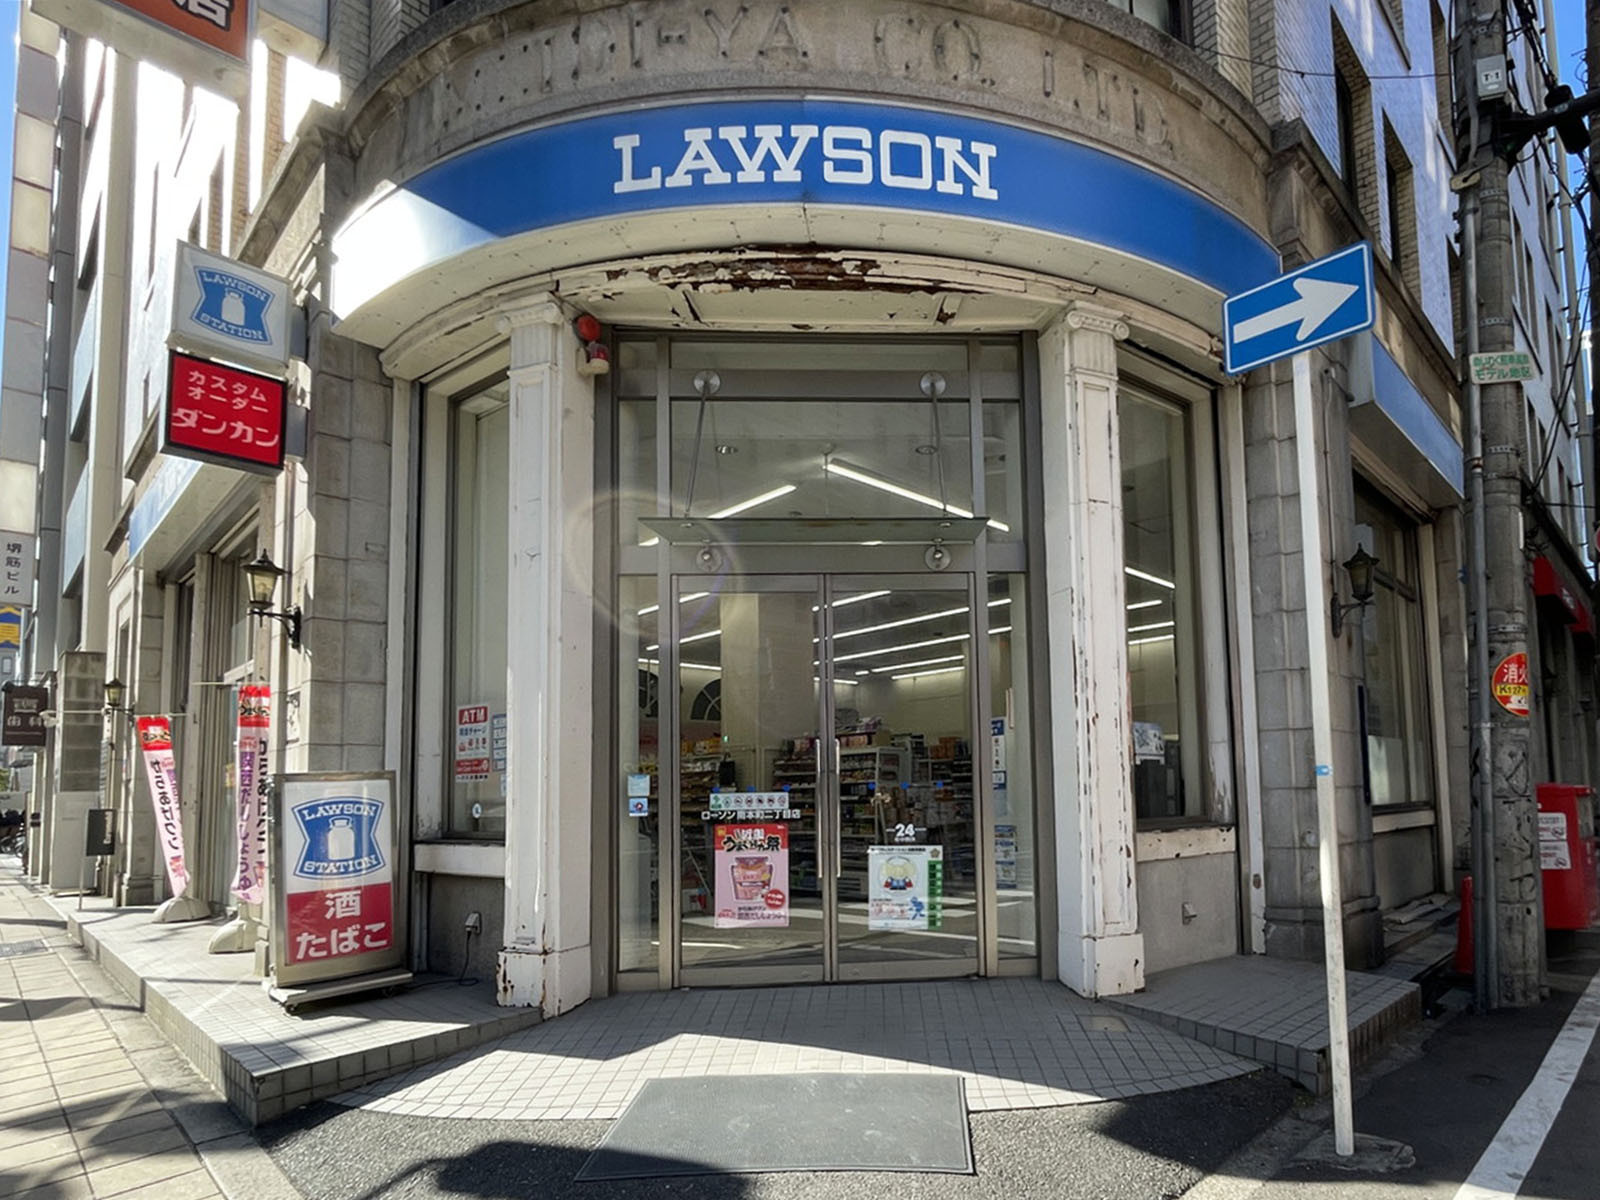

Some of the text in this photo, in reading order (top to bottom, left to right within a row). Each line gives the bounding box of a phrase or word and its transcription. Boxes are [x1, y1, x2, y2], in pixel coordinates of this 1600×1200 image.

[613, 124, 998, 200] LAWSON
[202, 271, 269, 301] LAWSON
[201, 312, 264, 340] STATION
[187, 386, 269, 413] オーダー
[188, 370, 267, 402] カスタム
[172, 407, 279, 447] ダンカン
[4, 542, 22, 594] 堺筋ビル
[461, 707, 486, 724] ATM
[302, 802, 377, 821] LAWSON
[895, 823, 916, 837] 24
[303, 853, 378, 874] STATION
[325, 889, 361, 919] 酒
[296, 922, 387, 960] たばこ
